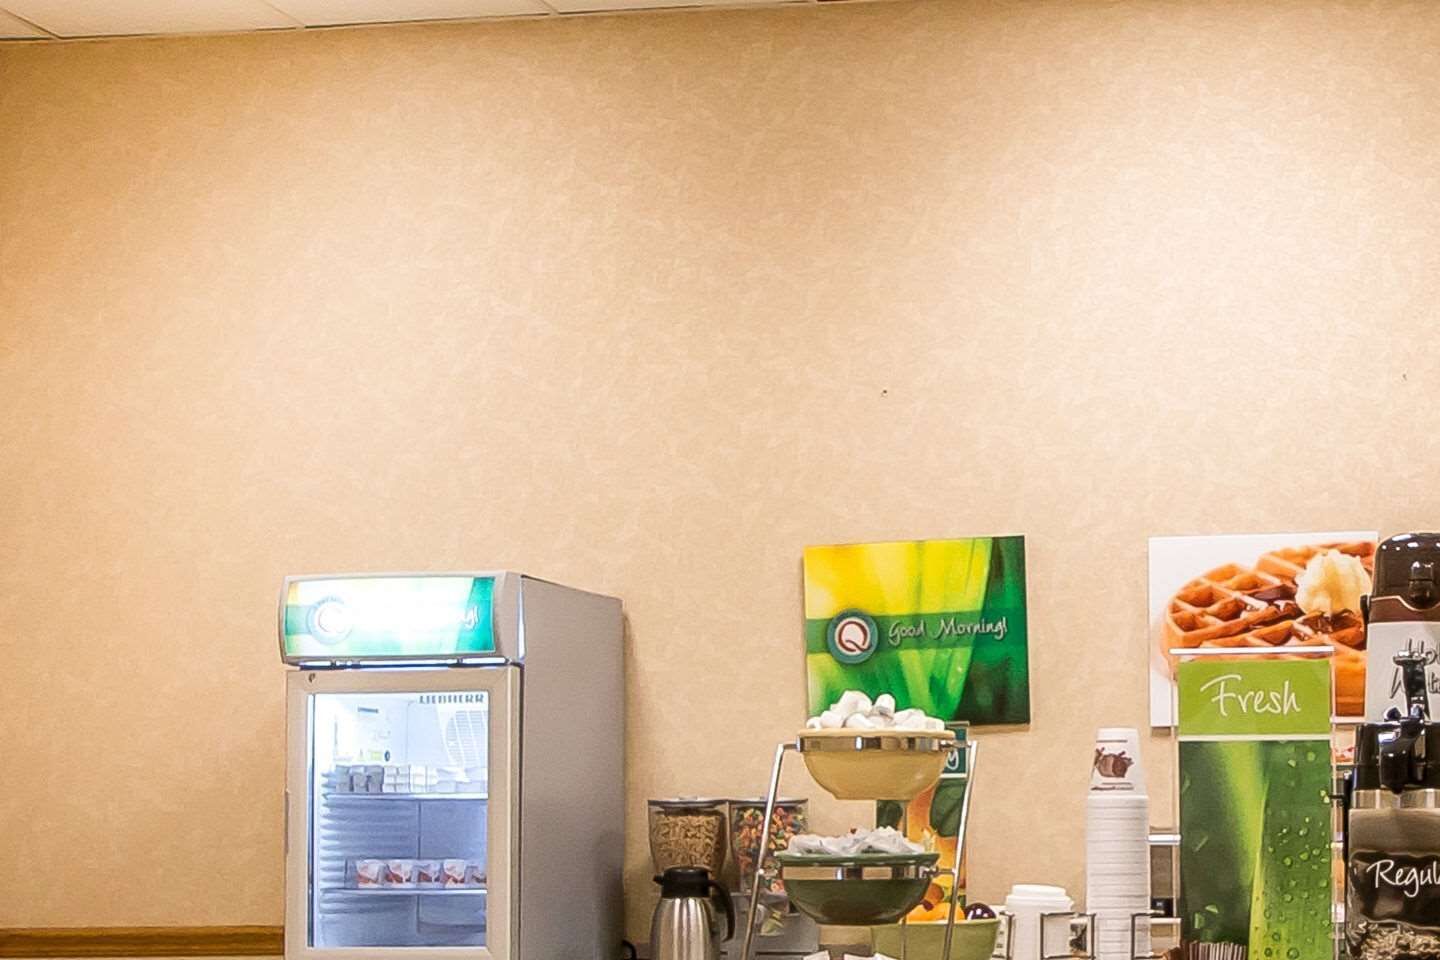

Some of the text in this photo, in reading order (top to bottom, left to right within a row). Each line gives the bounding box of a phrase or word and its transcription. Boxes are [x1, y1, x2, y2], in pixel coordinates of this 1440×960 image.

[839, 621, 870, 652] Q
[889, 617, 1008, 646] Good Morning!
[1200, 673, 1301, 716] Fresh
